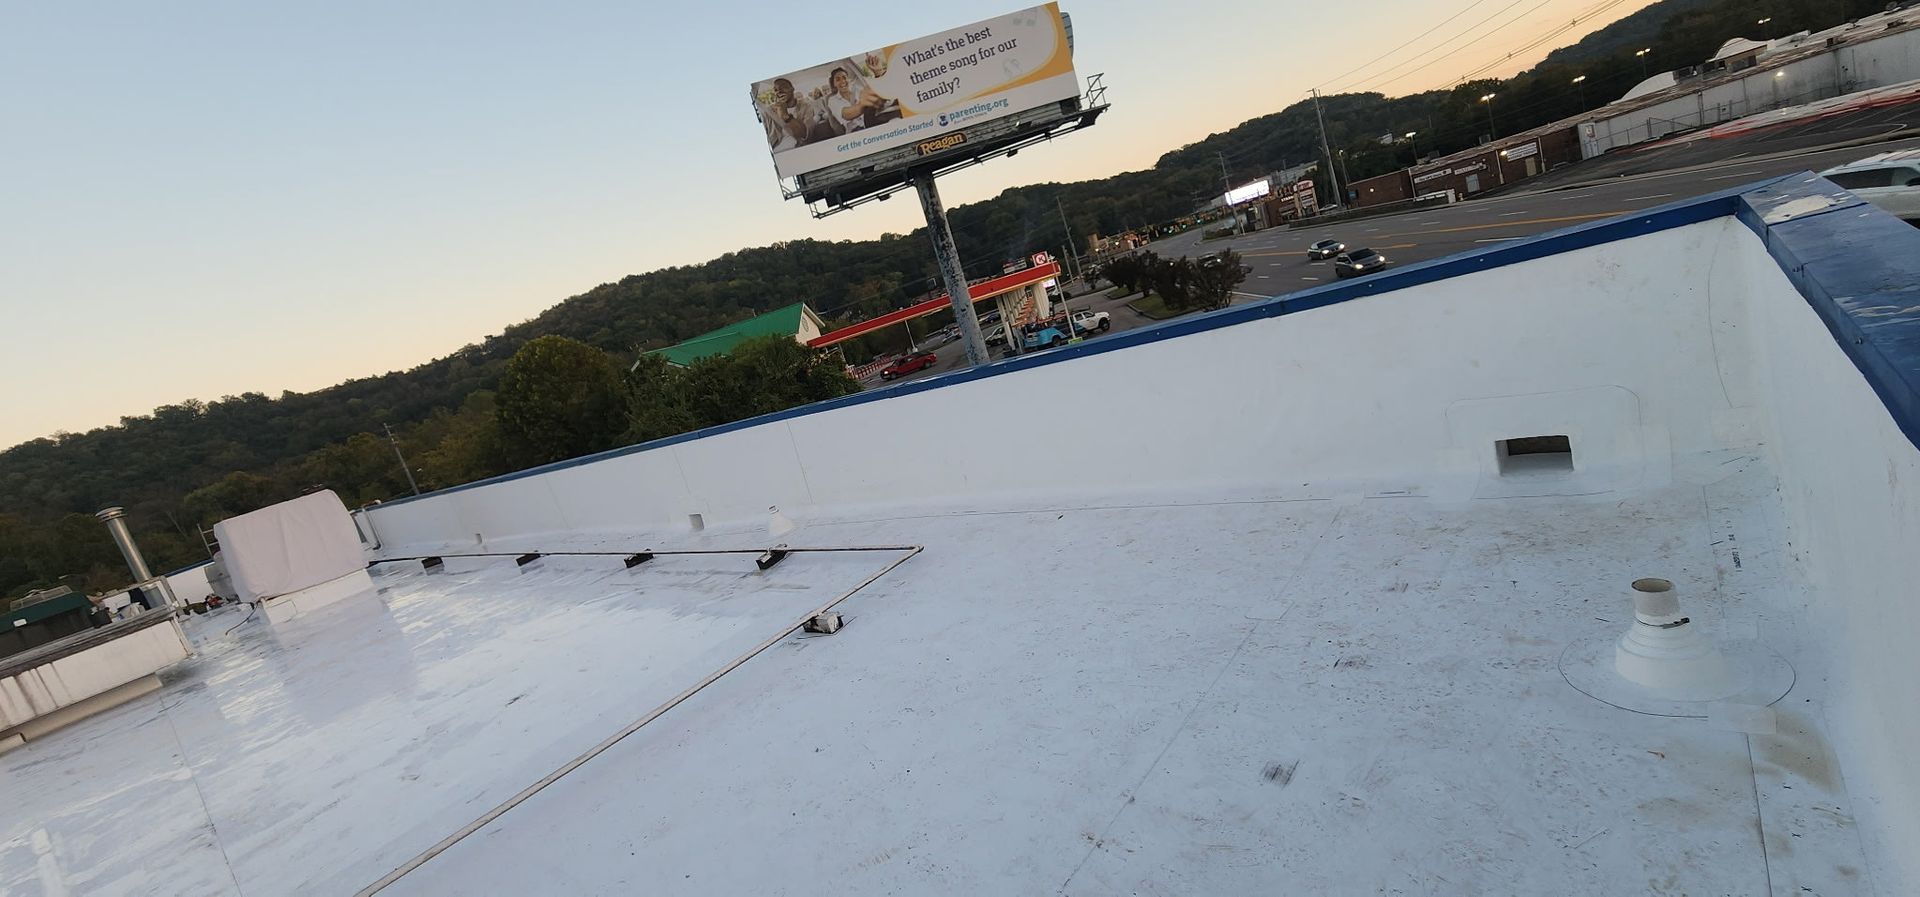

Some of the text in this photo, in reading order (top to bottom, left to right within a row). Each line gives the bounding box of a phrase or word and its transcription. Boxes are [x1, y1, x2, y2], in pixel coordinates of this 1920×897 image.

[902, 27, 992, 67] What's the best
[909, 38, 1017, 85] theme song for our
[916, 77, 960, 103] family?
[949, 98, 1009, 122] parenting.org
[837, 119, 934, 153] Get the Conversation Started
[919, 134, 963, 156] Reagan
